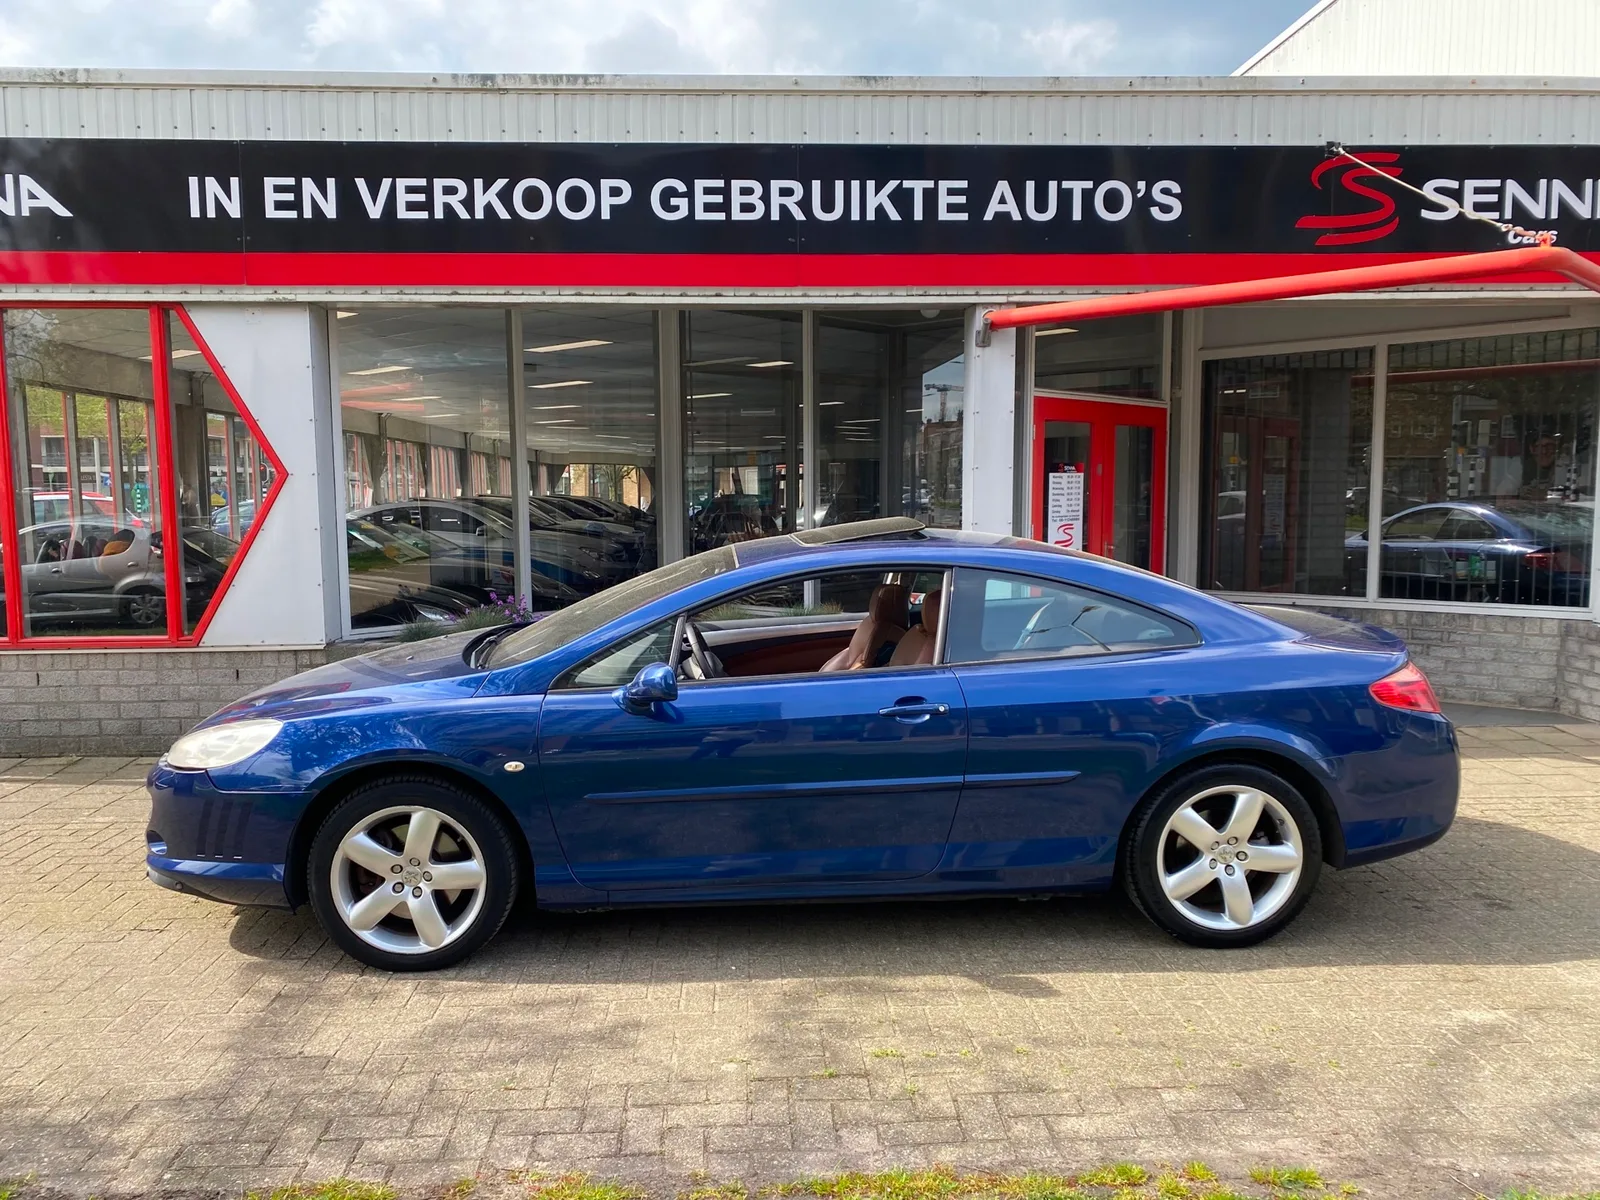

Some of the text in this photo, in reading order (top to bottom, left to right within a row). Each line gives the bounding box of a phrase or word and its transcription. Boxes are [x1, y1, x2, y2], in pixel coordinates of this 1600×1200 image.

[189, 176, 1183, 222] IN EN VERKOOP GEBRUIKTE AUTO’S
[1420, 178, 1600, 221] SENN
